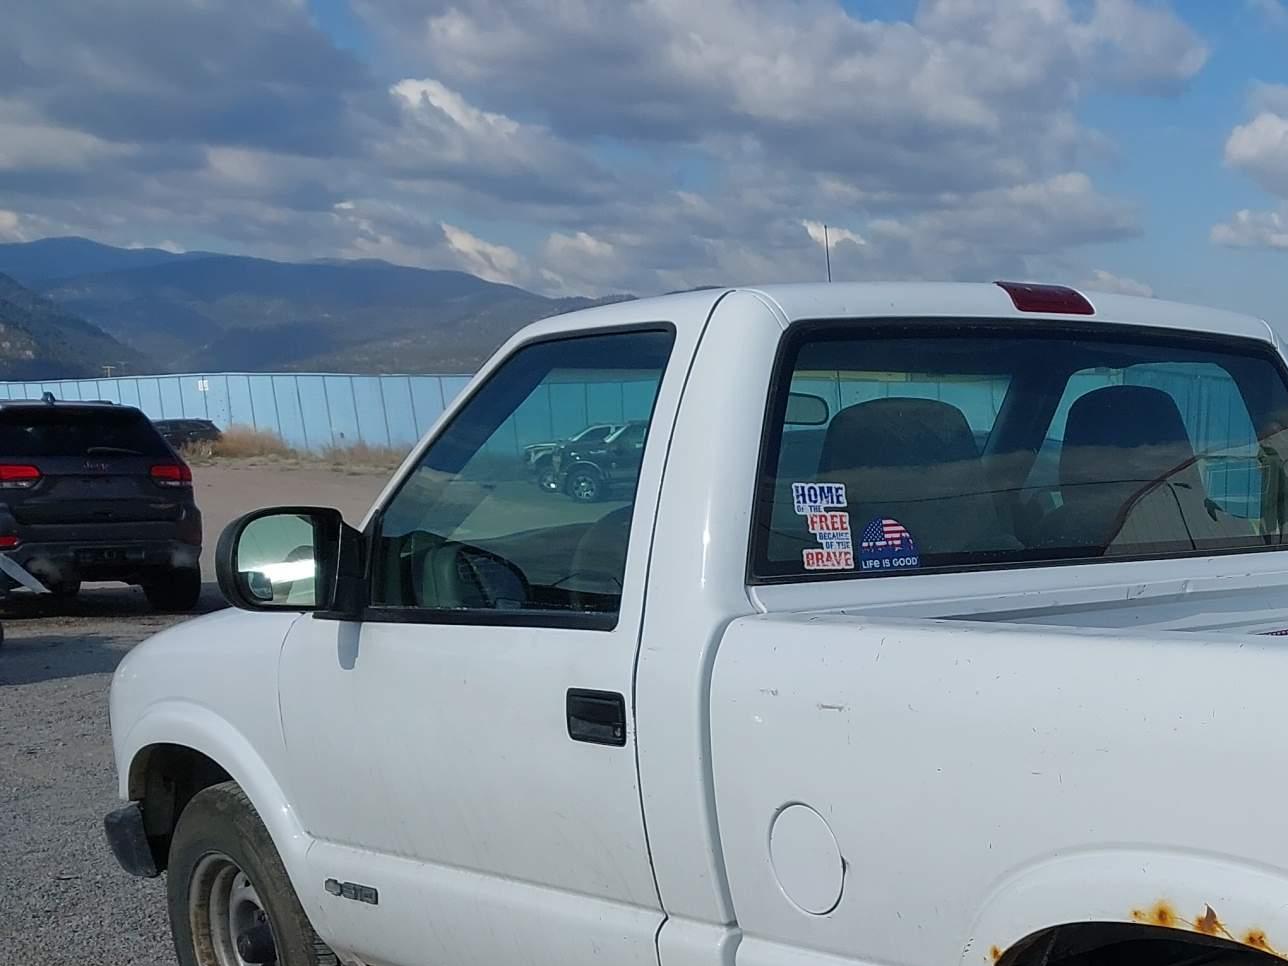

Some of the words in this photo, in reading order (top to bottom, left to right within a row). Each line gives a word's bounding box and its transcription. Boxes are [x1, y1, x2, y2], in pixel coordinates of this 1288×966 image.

[795, 485, 845, 505] HOME
[808, 505, 823, 513] THE
[810, 514, 849, 531] FREE
[805, 551, 852, 567] BRAVE
[882, 559, 891, 568] IS
[892, 557, 918, 567] GOOD
